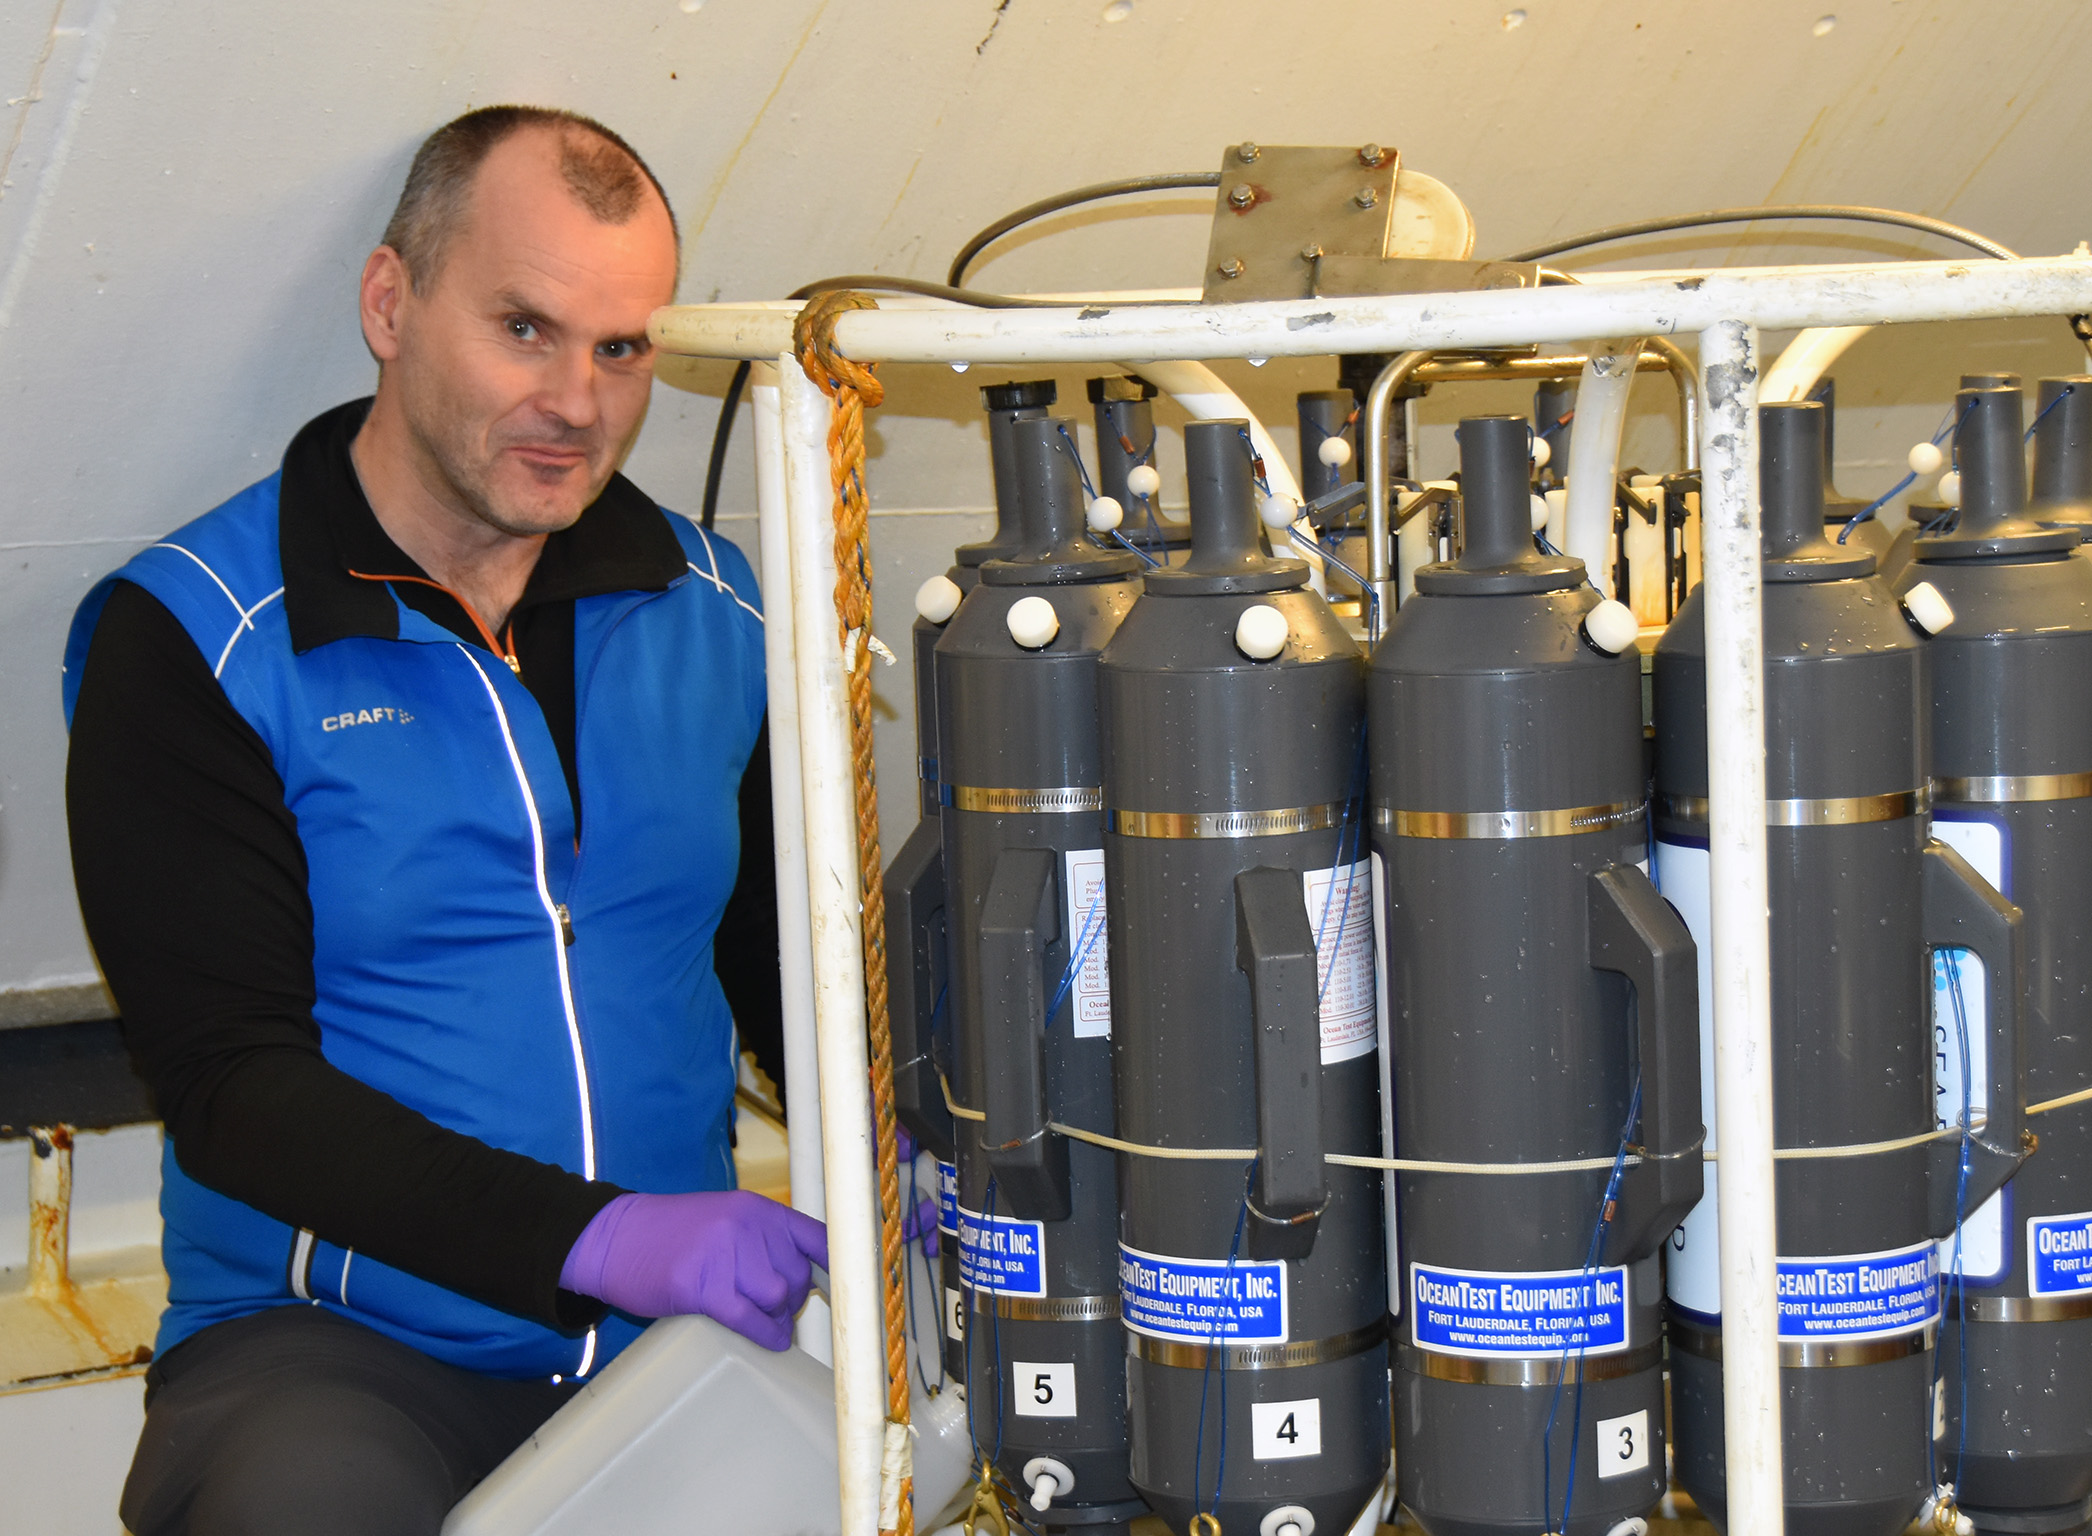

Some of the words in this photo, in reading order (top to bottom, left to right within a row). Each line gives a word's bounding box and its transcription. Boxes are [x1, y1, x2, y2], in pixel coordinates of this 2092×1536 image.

[322, 707, 395, 732] CRAFT
[1009, 1228, 1037, 1255] INC.
[1005, 1260, 1024, 1272] USA
[2053, 1258, 2081, 1272] FORT
[1159, 1267, 1242, 1302] EQUIPMENT,
[1246, 1272, 1278, 1299] INC.
[1418, 1275, 1497, 1310] OCEANTEST
[1595, 1279, 1621, 1306] INC.
[1776, 1269, 1855, 1295] CEANTEST
[1133, 1292, 1185, 1316] LAUDERDALE,
[1240, 1306, 1263, 1318] USA
[1778, 1302, 1808, 1315] FORT
[1812, 1299, 1886, 1315] LAUDERDALE,
[1804, 1306, 1926, 1329] www.oceantestequip.com
[1130, 1308, 1238, 1333] www.oceantestequipcm
[1428, 1310, 1453, 1326] FORT
[1456, 1314, 1532, 1331] LAUDERDALE,
[1535, 1316, 1585, 1331] FLORIA
[1590, 1312, 1611, 1326] USA
[1449, 1331, 1589, 1347] www.oceantestequip.om
[1033, 1374, 1053, 1404] 5
[1276, 1412, 1299, 1444] 4
[1618, 1426, 1633, 1461] 3
